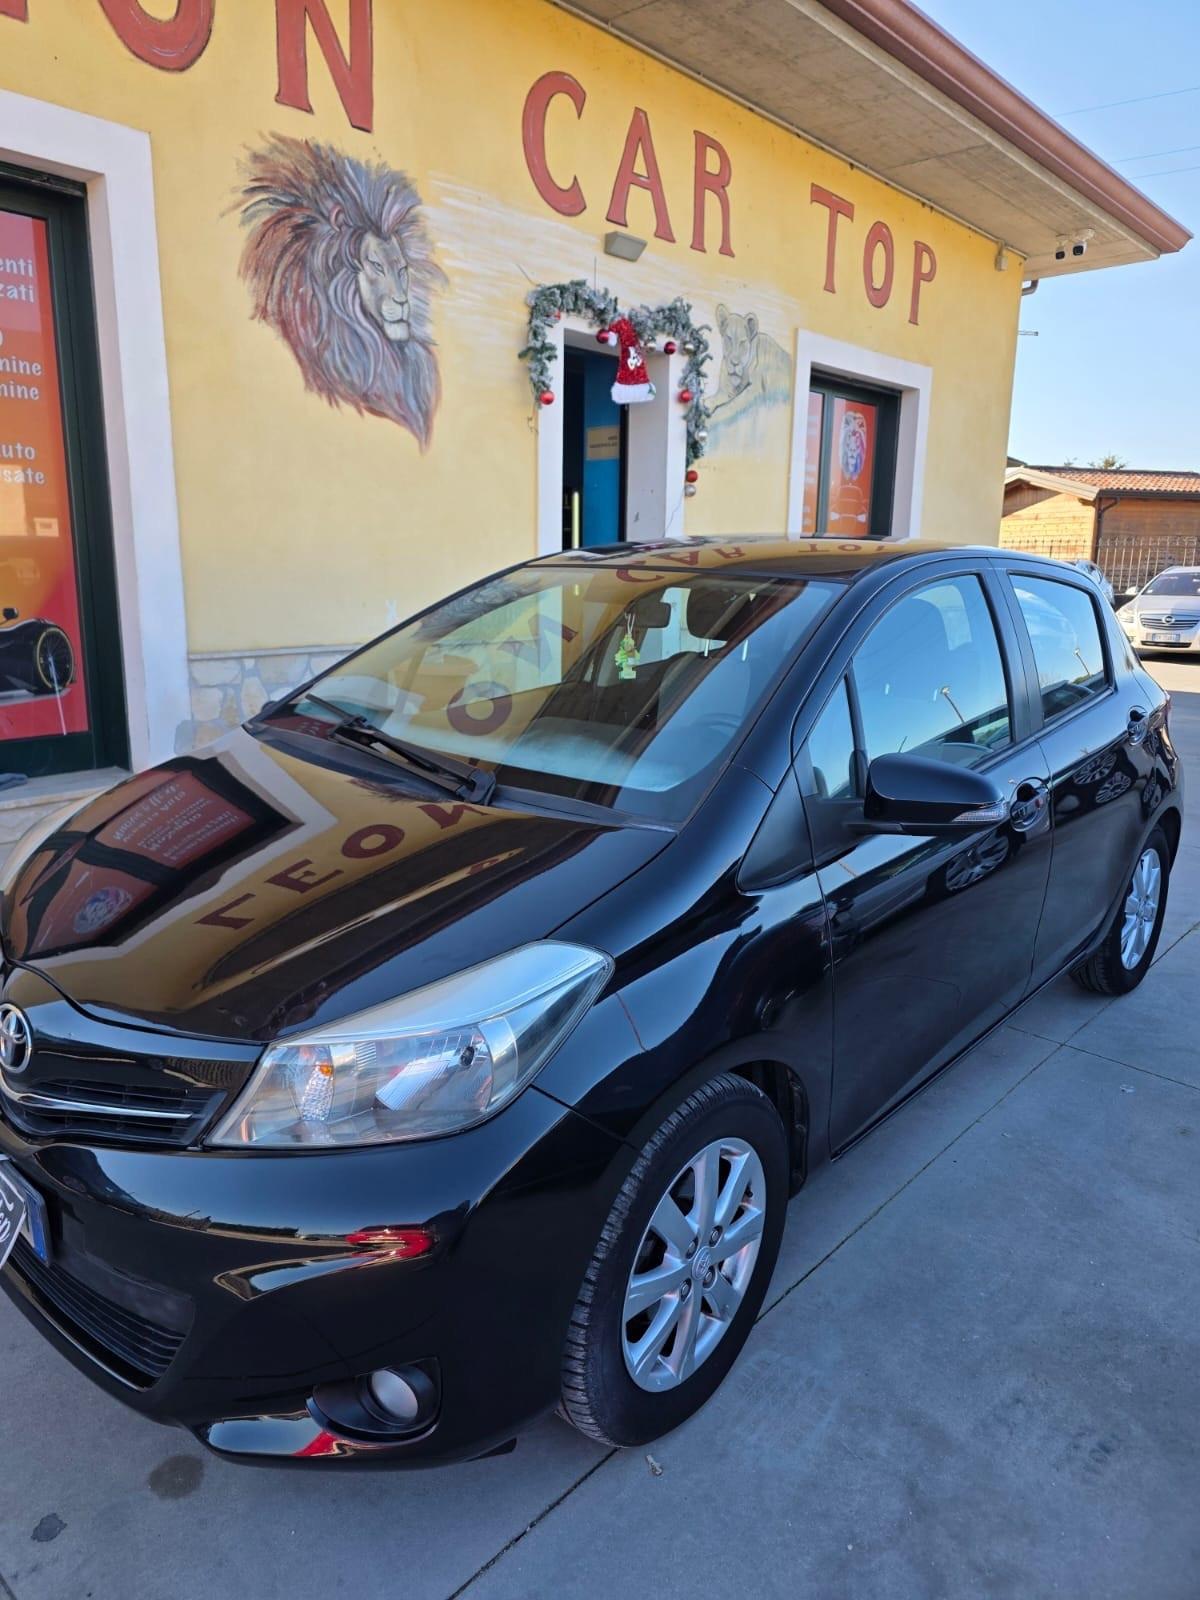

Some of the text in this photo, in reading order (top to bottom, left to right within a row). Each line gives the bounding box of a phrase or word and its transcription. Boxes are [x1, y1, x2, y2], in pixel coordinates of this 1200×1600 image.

[522, 71, 937, 325] CAR TOP
[0, 442, 35, 460] uto
[0, 467, 45, 485] sate
